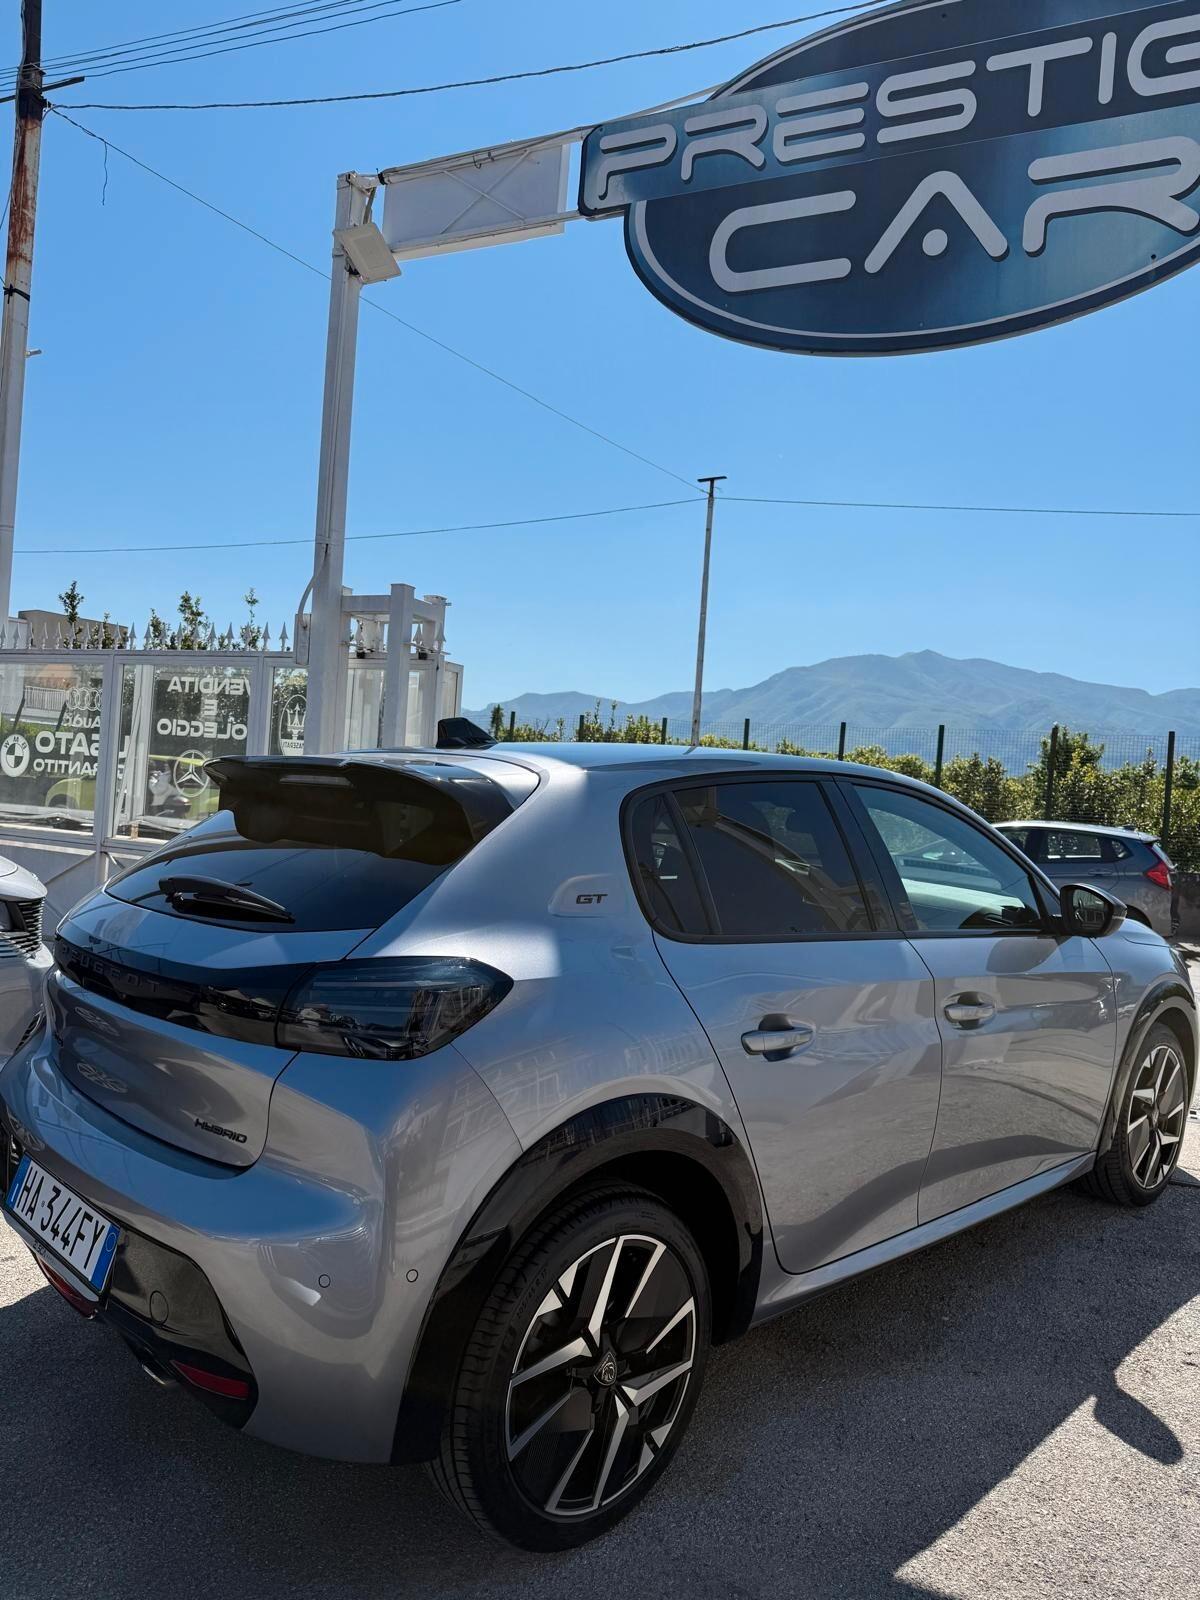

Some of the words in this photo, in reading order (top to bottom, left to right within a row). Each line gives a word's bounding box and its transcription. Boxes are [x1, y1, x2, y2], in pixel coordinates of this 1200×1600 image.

[709, 135, 1200, 292] CAR
[576, 894, 608, 905] GT
[61, 943, 161, 993] PEUGEOT
[194, 1118, 248, 1143] HYBRID
